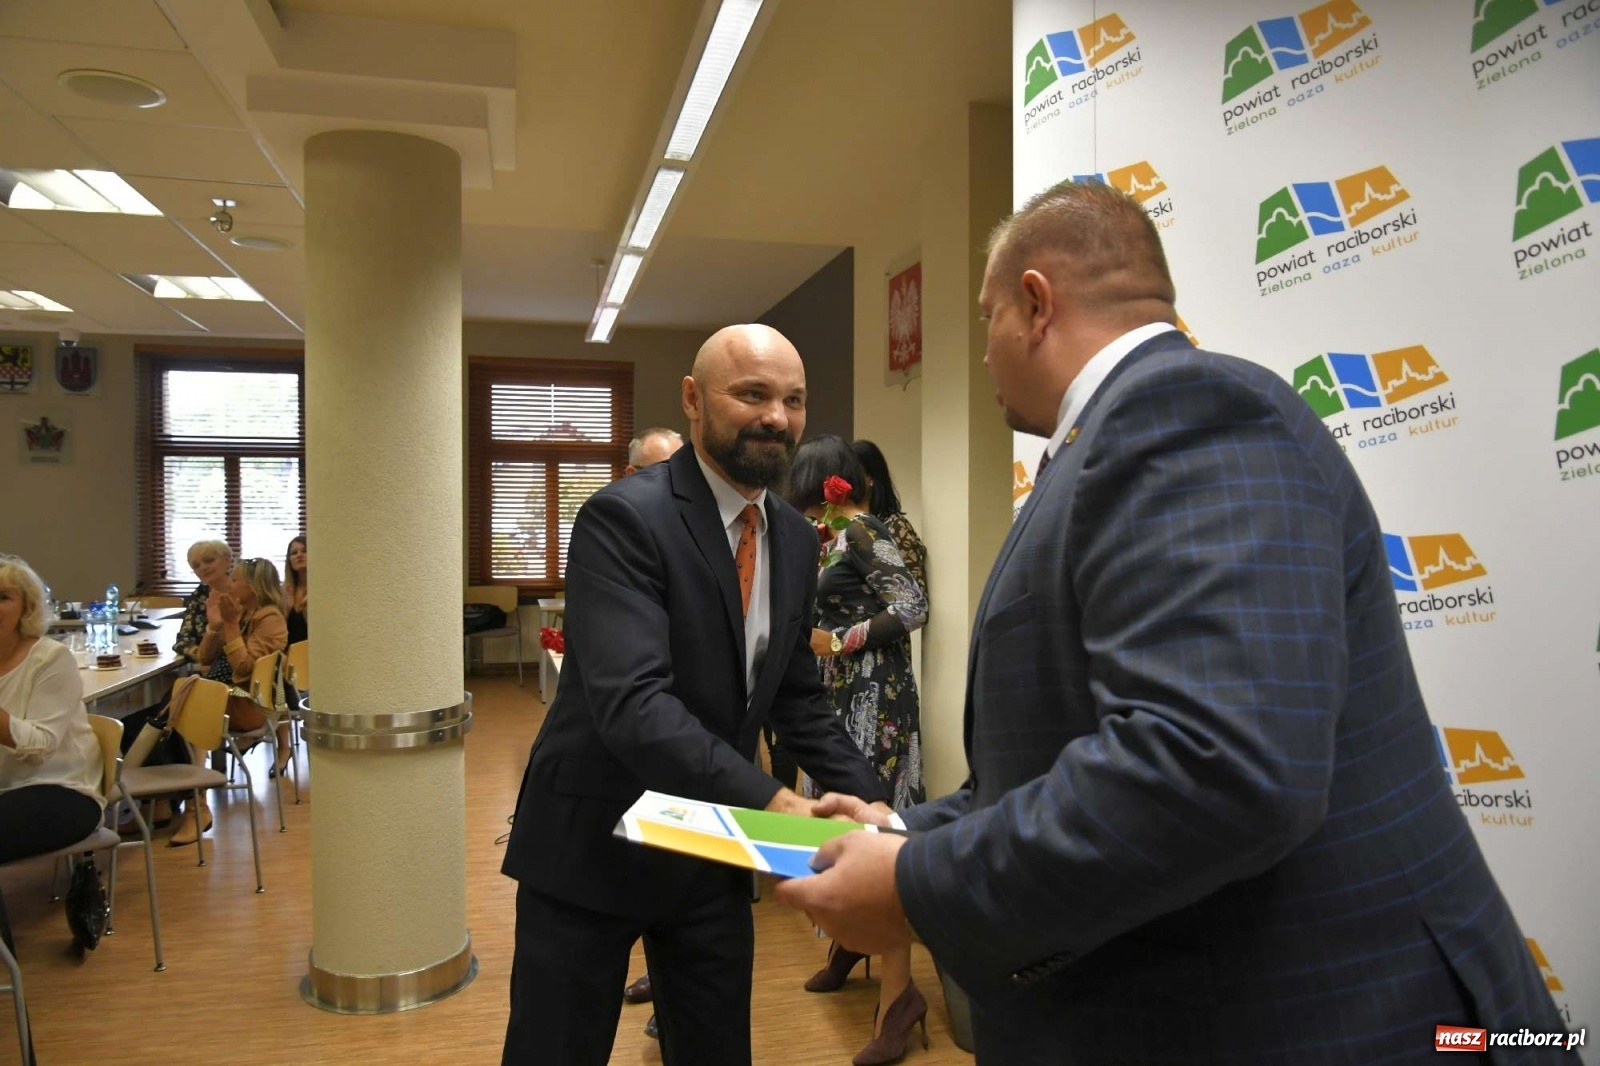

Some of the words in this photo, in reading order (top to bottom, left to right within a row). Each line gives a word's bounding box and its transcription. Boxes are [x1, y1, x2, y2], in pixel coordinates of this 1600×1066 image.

[1472, 24, 1548, 79] powiat
[1476, 51, 1542, 90] zielona
[1024, 90, 1064, 127] powiat
[1071, 47, 1141, 94] raciborski
[1026, 108, 1061, 135] zielona
[1068, 90, 1098, 109] oaza
[1105, 65, 1144, 90] kultur
[1223, 85, 1281, 126] powiat
[1291, 33, 1379, 89] raciborski
[1226, 106, 1277, 136] zielona
[1287, 84, 1324, 107] oaza
[1334, 55, 1382, 83] kultur
[1257, 250, 1316, 287] powiat
[1327, 208, 1417, 257] raciborski
[1260, 271, 1312, 297] zielona
[1323, 254, 1361, 274] oaza
[1371, 231, 1420, 256] kultur
[1514, 221, 1592, 269] powiat
[1518, 248, 1586, 280] zielona
[1358, 432, 1397, 449] oaza
[1408, 416, 1459, 436] kultur
[1363, 392, 1456, 432] raciborski
[1398, 586, 1494, 614] raciborski
[1445, 611, 1496, 626] kultur
[1481, 812, 1535, 827] kultur
